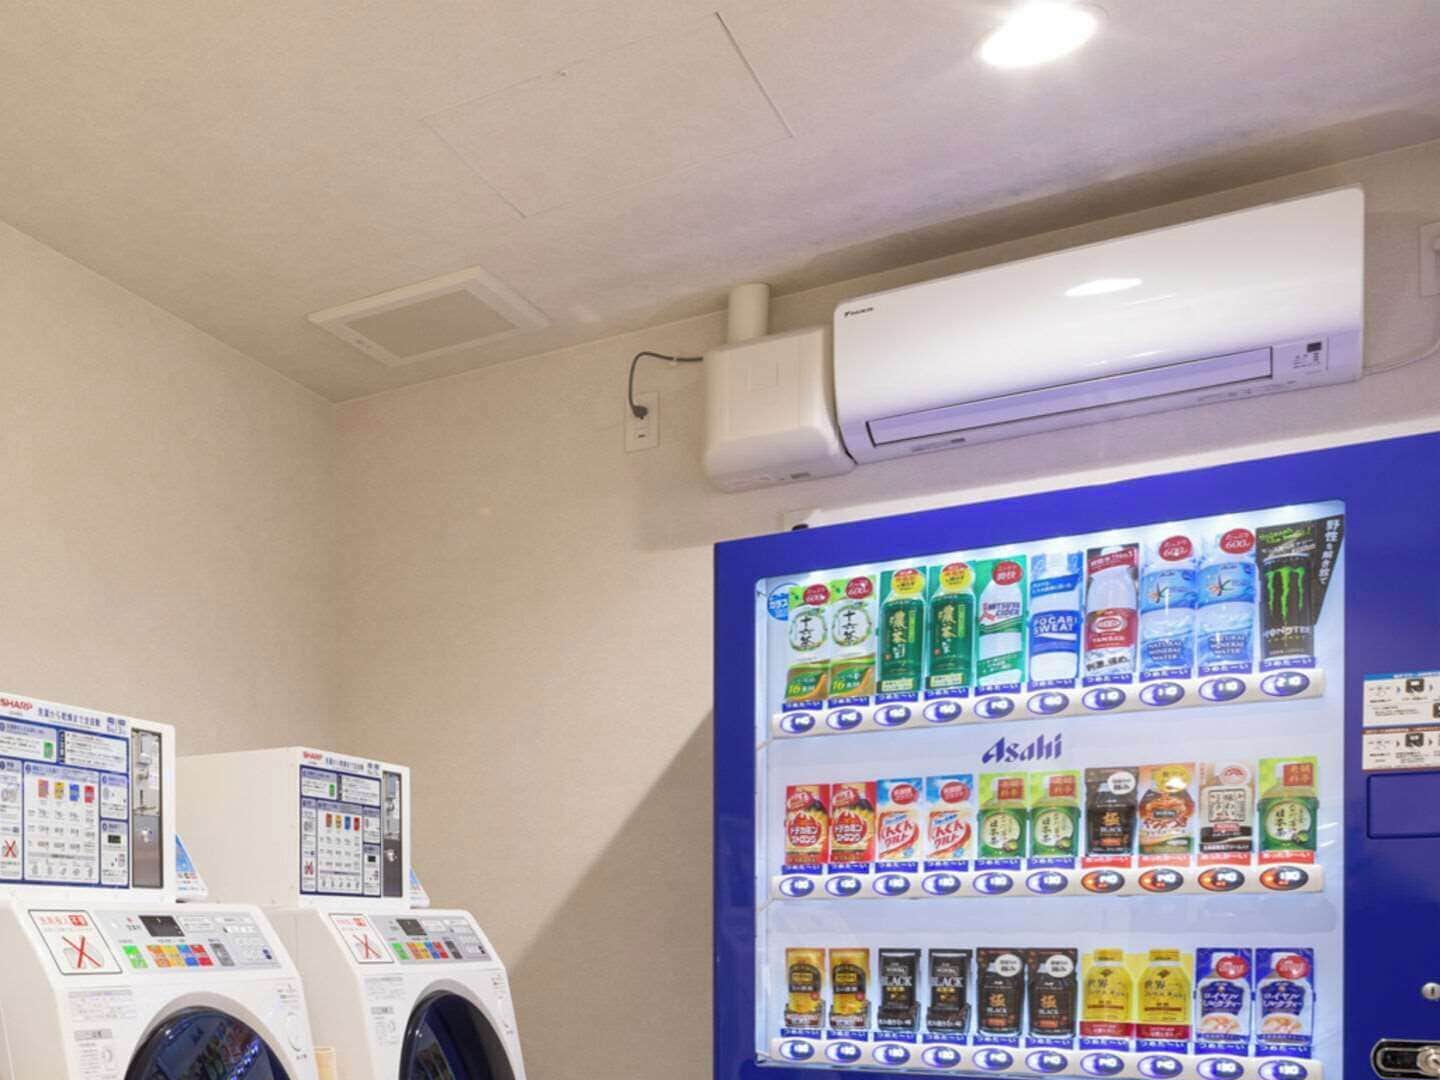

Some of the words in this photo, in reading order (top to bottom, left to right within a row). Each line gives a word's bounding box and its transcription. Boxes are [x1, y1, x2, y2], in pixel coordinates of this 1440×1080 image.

[799, 616, 816, 647] 十六茶
[842, 610, 859, 646] 十六茶
[1033, 624, 1074, 635] SWEAT
[1034, 616, 1078, 626] POCARI
[0, 698, 33, 711] SHARP
[982, 732, 1063, 764] Asahi
